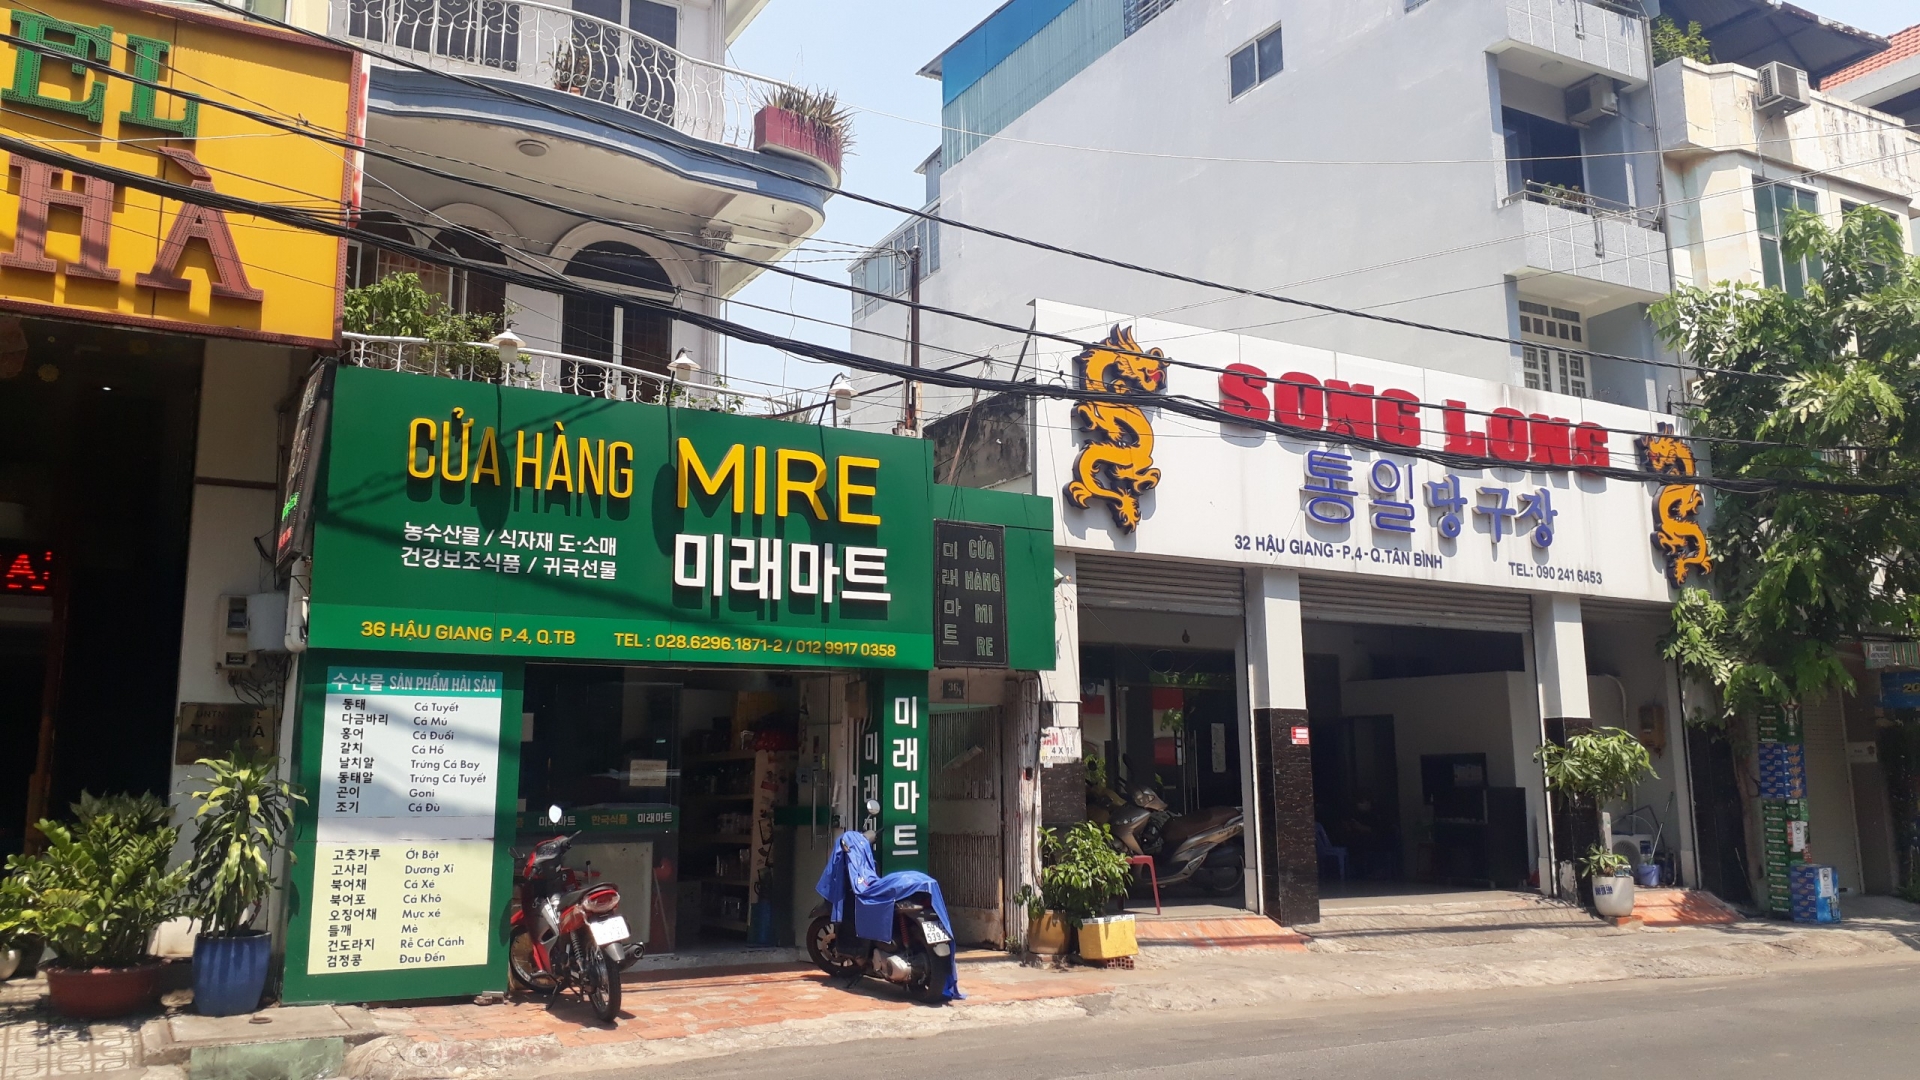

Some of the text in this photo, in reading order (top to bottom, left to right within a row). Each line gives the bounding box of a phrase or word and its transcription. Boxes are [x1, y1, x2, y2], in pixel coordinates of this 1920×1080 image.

[1217, 363, 1609, 469] SONG LONG
[408, 407, 633, 498] CỬA HÀNG
[676, 437, 881, 525] MIRE
[403, 522, 480, 546] 농수산물
[499, 529, 553, 552] 식자재
[968, 535, 995, 560] CỬA
[1234, 534, 1251, 551] 32
[1255, 534, 1286, 556] HẬU
[1414, 549, 1444, 569] BÌNH
[400, 546, 521, 573] 건강보조식품
[543, 556, 617, 580] 귀국선물
[674, 533, 892, 603] 미래마트
[964, 568, 1000, 593] HÀNG
[1536, 565, 1556, 580] 090
[1557, 567, 1575, 582] 241
[1577, 569, 1603, 585] 6453
[974, 603, 993, 624] MI
[360, 621, 386, 637] 36
[390, 619, 431, 641] HẬU
[435, 624, 493, 641] GIANG
[537, 629, 576, 645] Q.TB
[655, 633, 783, 653] 028.6296.1871-2
[795, 640, 822, 654] 012
[824, 641, 858, 656] 9917
[860, 643, 897, 658] 0358
[976, 636, 994, 656] RE
[331, 672, 386, 692] 수산물
[342, 698, 366, 711] 동태
[414, 702, 429, 712] Cá
[341, 713, 389, 725] 다금바리
[413, 716, 428, 726] Cá
[412, 731, 427, 740] Cá
[340, 742, 363, 754] 갈치
[411, 745, 426, 755] Cá
[443, 760, 457, 769] Cá
[460, 760, 480, 771] Bay
[442, 774, 457, 783] Cá
[892, 696, 920, 856] 미래마트
[409, 788, 435, 798] Goni
[335, 801, 359, 813] 조기
[408, 803, 423, 812] Cá
[539, 816, 577, 827] 미마트
[637, 811, 673, 823] 미래마트
[332, 849, 381, 861] 고춧가루
[331, 863, 368, 876] 고사리
[330, 878, 367, 891] 북어채
[404, 879, 419, 889] Cá
[330, 893, 366, 906] 북어포
[403, 893, 442, 904] Cá Khô
[329, 908, 377, 921] 오징어채
[401, 924, 418, 933] Mè
[327, 938, 375, 952] 건도라지
[416, 938, 435, 948] Cát
[437, 936, 465, 947] Cánh
[326, 953, 362, 968] 검정콩
